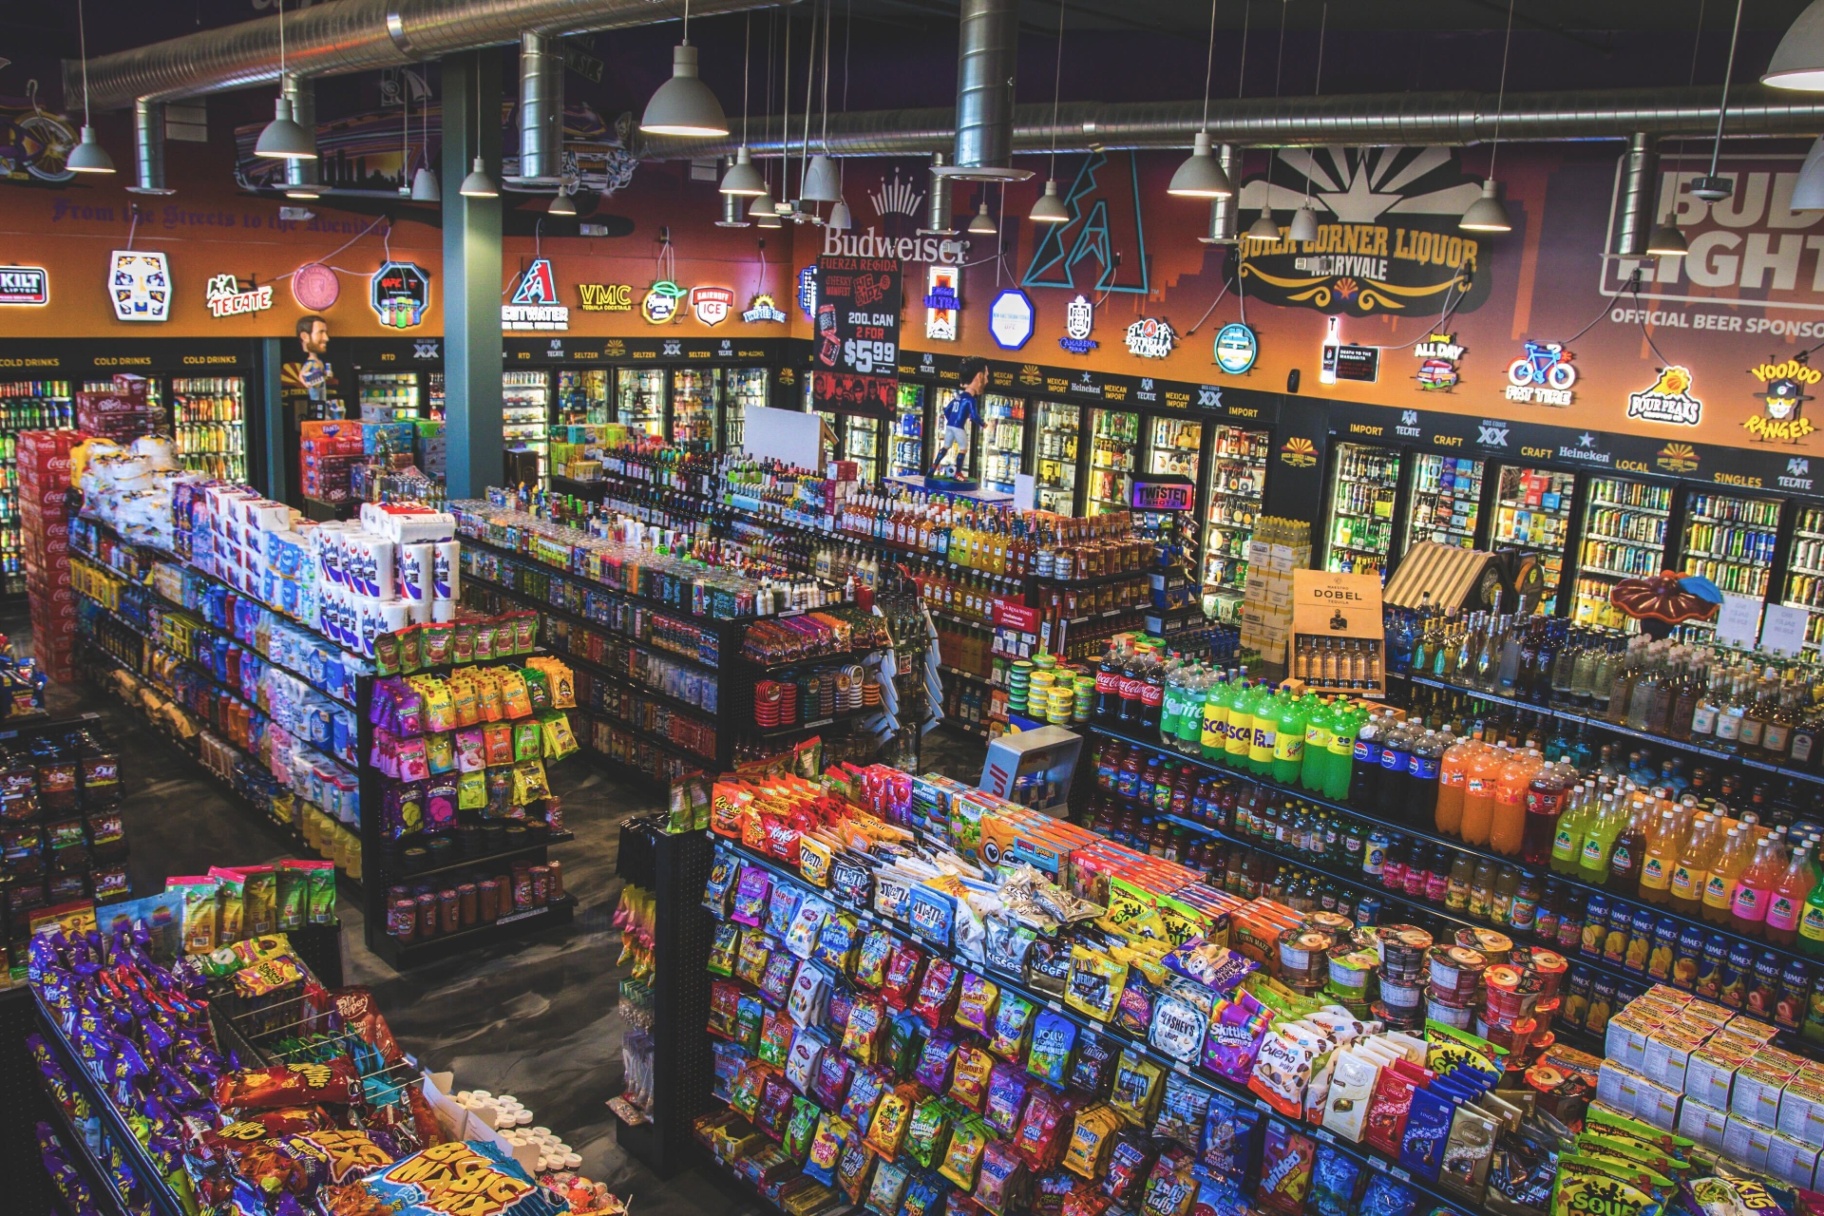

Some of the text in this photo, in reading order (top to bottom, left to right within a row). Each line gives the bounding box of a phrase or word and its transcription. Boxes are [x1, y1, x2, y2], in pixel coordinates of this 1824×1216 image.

[52, 196, 114, 222] From
[163, 203, 236, 230] Streets
[243, 211, 262, 229] to
[822, 224, 971, 264] Budweiser
[1302, 224, 1388, 257] CORNER
[1393, 228, 1478, 272] LIQUOR
[820, 258, 898, 272] FUERZA REGIDA
[1, 273, 41, 288] KILT
[579, 284, 632, 305] VMC
[211, 290, 270, 316] TECATE
[703, 303, 721, 315] ICE
[924, 295, 961, 310] ULTRA
[872, 313, 894, 327] CAN
[1610, 308, 1690, 328] OFFICIAL
[1693, 313, 1742, 332] BEER
[856, 327, 884, 340] 2 FOR
[413, 344, 439, 358] XX
[518, 352, 531, 360] RTD
[663, 344, 682, 355] XX
[1415, 343, 1464, 360] ALL DAY
[0, 358, 60, 367] COLD DRINKS
[94, 357, 152, 365] COLD DRINKS
[183, 355, 237, 364] COLD DRINKS
[382, 354, 396, 362] RTD
[940, 371, 960, 380] DOMEST
[993, 371, 1014, 380] MEXICAN
[1752, 360, 1822, 385] VOODOO
[994, 378, 1012, 387] IMPORT
[1047, 377, 1069, 386] MEXICAN
[1071, 382, 1101, 394] Heineken
[1048, 385, 1067, 394] IMPORT
[1104, 384, 1128, 394] MEXICAN
[1105, 391, 1125, 401] IMPORT
[1137, 391, 1157, 401] TECATE
[1505, 386, 1533, 402] FAT
[1165, 391, 1190, 402] MEXICAN
[1197, 390, 1223, 408] XX
[1166, 399, 1188, 409] IMPORT
[1629, 395, 1699, 423] FOUR PEAKS
[1229, 406, 1258, 418] IMPORT
[1350, 423, 1383, 436] IMPORT
[1396, 425, 1421, 437] TECATE
[1743, 415, 1815, 439] RANGER
[1433, 435, 1463, 447] CRAFT
[1477, 426, 1510, 447] XX
[1521, 446, 1553, 459] CRAFT
[1559, 446, 1610, 463] Heineken
[1615, 459, 1649, 473] LOCAL
[1714, 472, 1763, 488] SINGLES
[1777, 476, 1813, 490] TECATE
[1314, 589, 1363, 601] DOBEL
[1382, 756, 1395, 764] PEPSI
[912, 786, 936, 802] Jefferson
[921, 784, 936, 795] Justin
[1240, 934, 1268, 951] CORN MAZE
[986, 952, 1022, 973] KISSES
[1312, 1019, 1334, 1030] kinder
[1037, 1030, 1064, 1039] JOLLY
[1210, 1023, 1253, 1041] Skittles
[1282, 1029, 1299, 1043] kinder
[1216, 1035, 1252, 1047] Gummies
[1261, 1040, 1296, 1064] bueno
[1279, 1061, 1294, 1072] mini
[1587, 1123, 1630, 1138] FAMILY SIZE
[813, 1139, 838, 1159] Swedish
[815, 1150, 829, 1164] Fish
[1261, 1151, 1301, 1194] Twizzlers
[1562, 1162, 1589, 1174] FAMILY
[1154, 1178, 1186, 1202] Laffy
[1146, 1191, 1177, 1214] Taffy
[1572, 1190, 1639, 1214] SOUR
